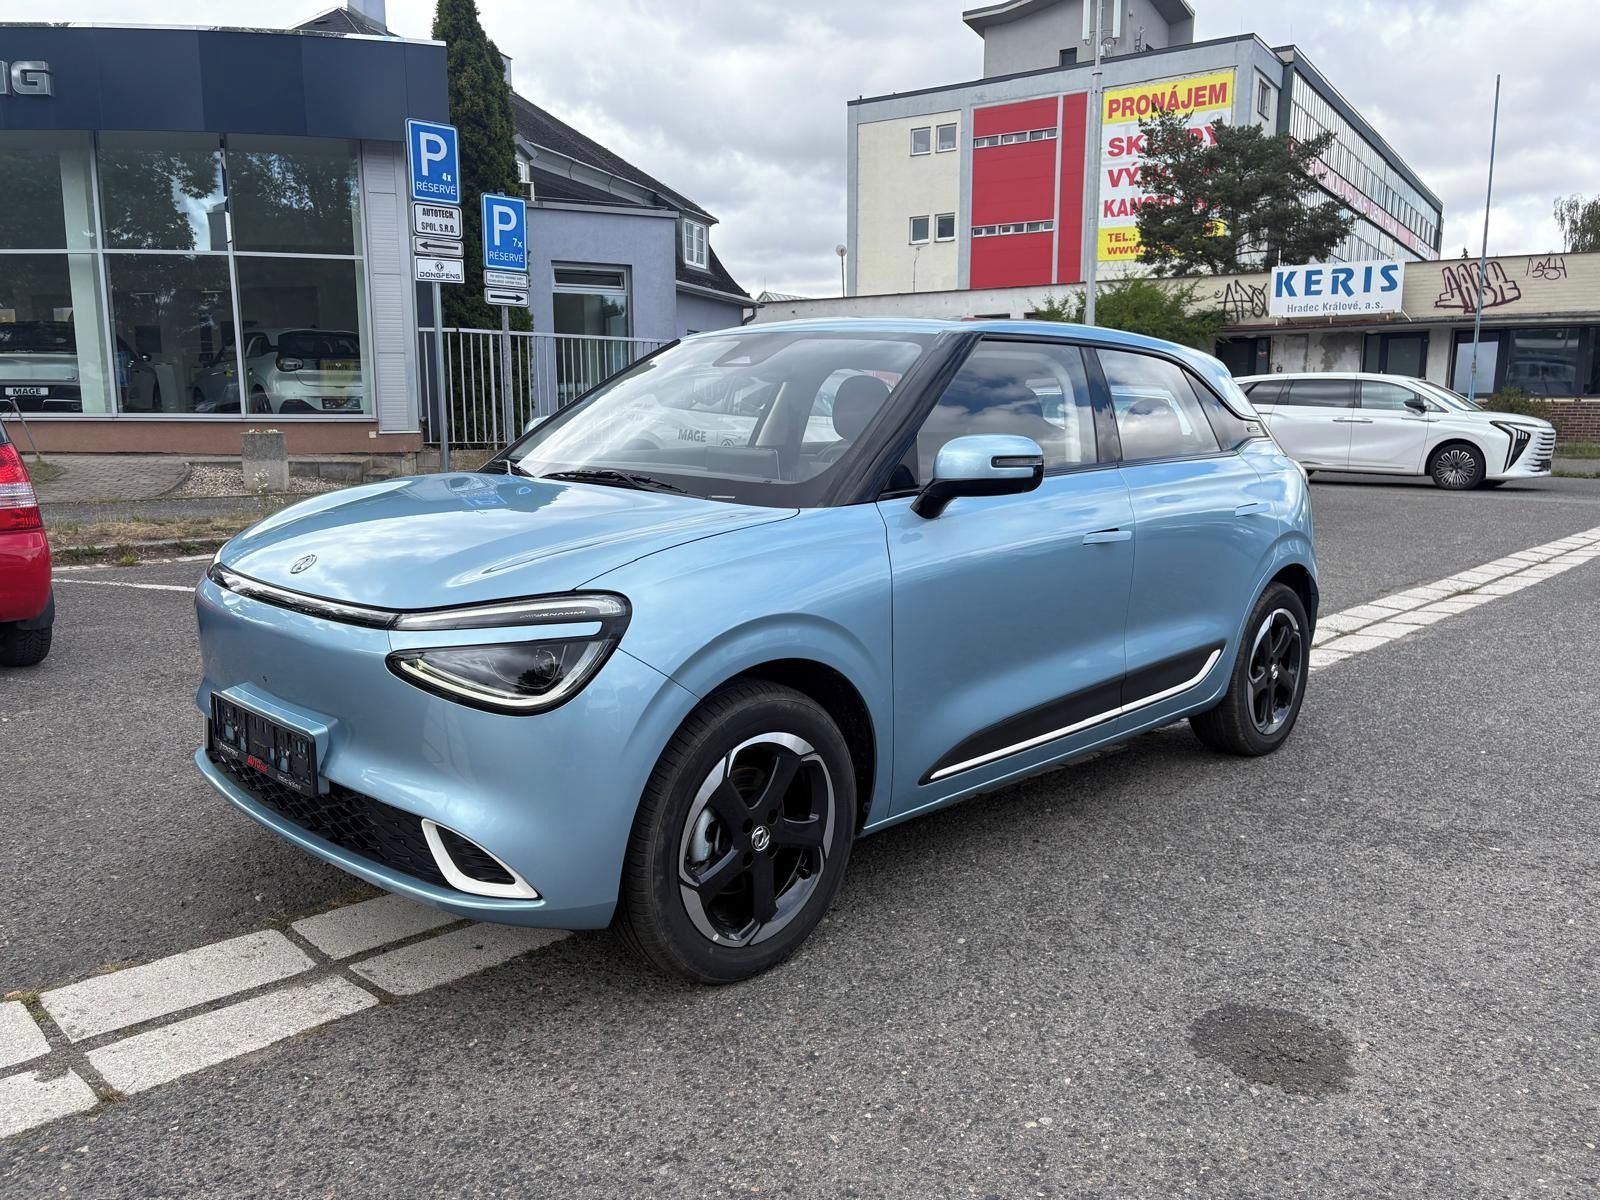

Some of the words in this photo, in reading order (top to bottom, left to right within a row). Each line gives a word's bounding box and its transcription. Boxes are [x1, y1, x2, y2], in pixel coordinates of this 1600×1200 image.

[0, 60, 51, 96] G
[1107, 84, 1228, 119] PRONÁJEM
[419, 131, 448, 177] P
[416, 180, 456, 196] RÉSERVÉ
[421, 221, 438, 232] SPOL.
[440, 223, 457, 234] S.R.O.
[492, 204, 518, 247] P
[512, 237, 524, 249] 7x
[1107, 232, 1137, 243] TEL.:
[488, 249, 524, 263] RÉSERVÉ
[419, 271, 461, 280] DONGFENG
[1275, 264, 1399, 298] KERIS
[1287, 303, 1319, 313] Hradec
[1322, 301, 1362, 313] Králové,
[1364, 301, 1384, 310] a.s.
[12, 387, 42, 395] MAGE
[677, 428, 707, 443] MAGE
